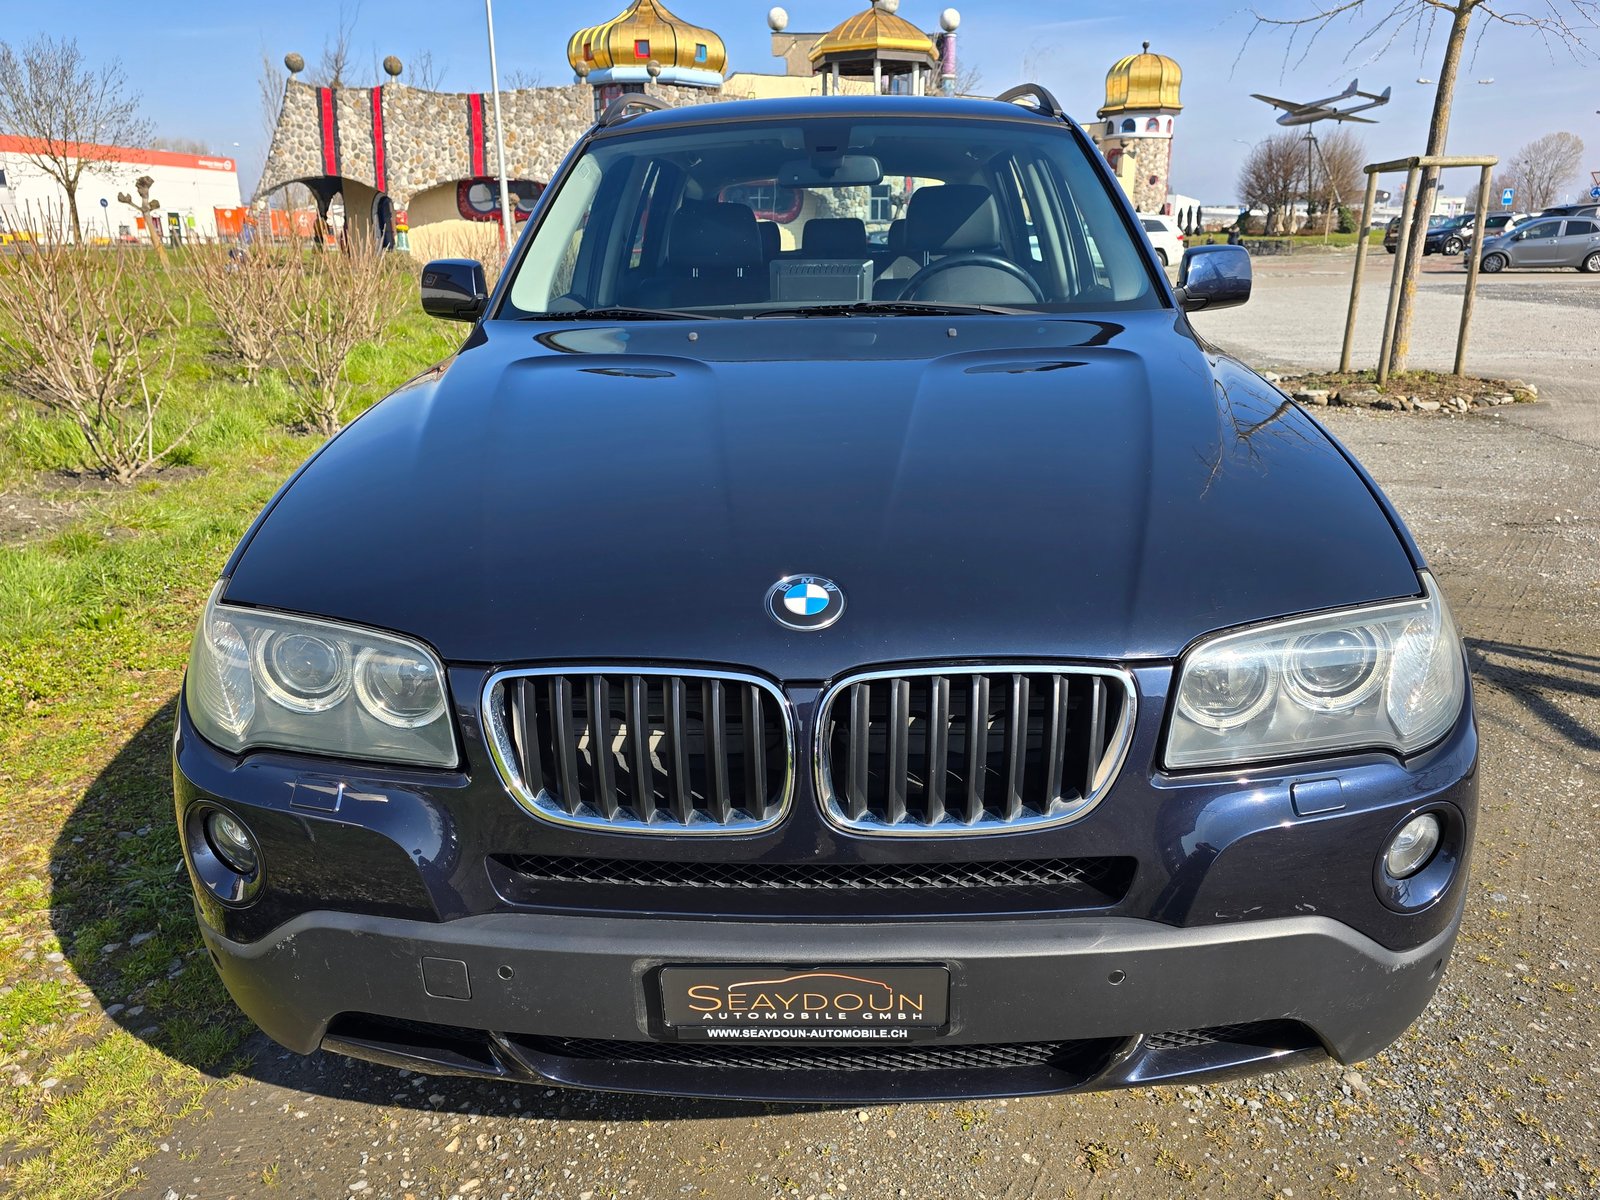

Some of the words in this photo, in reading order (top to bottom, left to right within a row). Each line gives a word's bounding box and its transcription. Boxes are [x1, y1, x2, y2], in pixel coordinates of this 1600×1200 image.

[779, 576, 837, 592] BMW
[687, 985, 924, 1011] SEAYDOUN
[702, 1012, 847, 1020] AUTOMOBILE
[862, 1012, 923, 1020] GMBH
[707, 1029, 908, 1039] WWW.SEAYDOUN-AUTOMOBILE.CH
